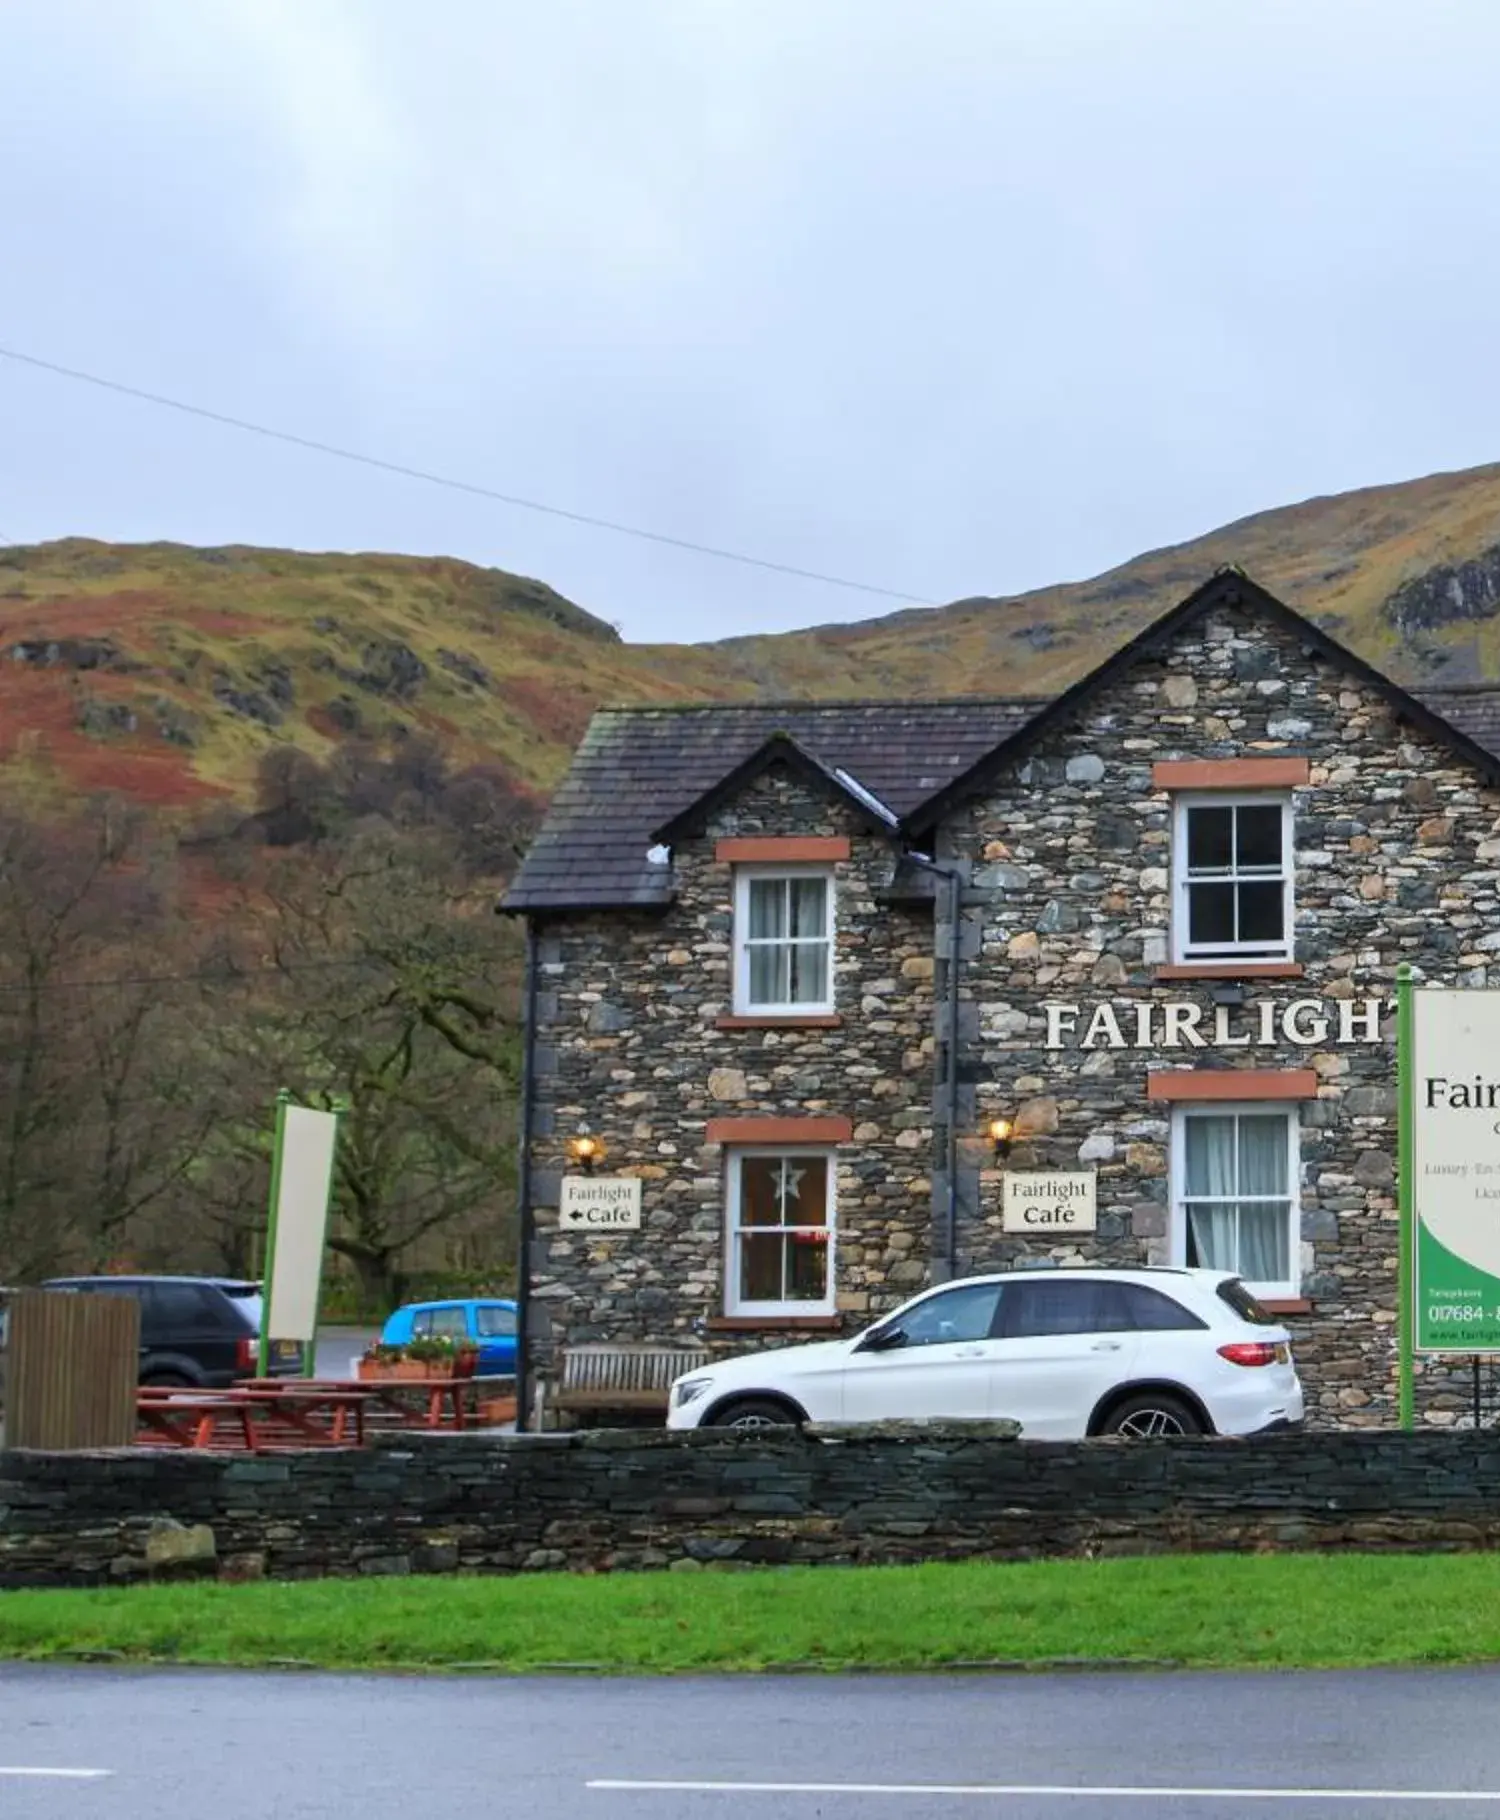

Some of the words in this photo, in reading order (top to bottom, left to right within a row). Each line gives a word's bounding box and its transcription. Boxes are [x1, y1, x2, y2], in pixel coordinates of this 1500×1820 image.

[1044, 998, 1398, 1050] FAIRLIGH
[568, 1186, 632, 1203] Fairlight
[1012, 1181, 1086, 1203] Fairlight
[1024, 1203, 1075, 1224] Café
[1428, 1305, 1483, 1322] 017684
